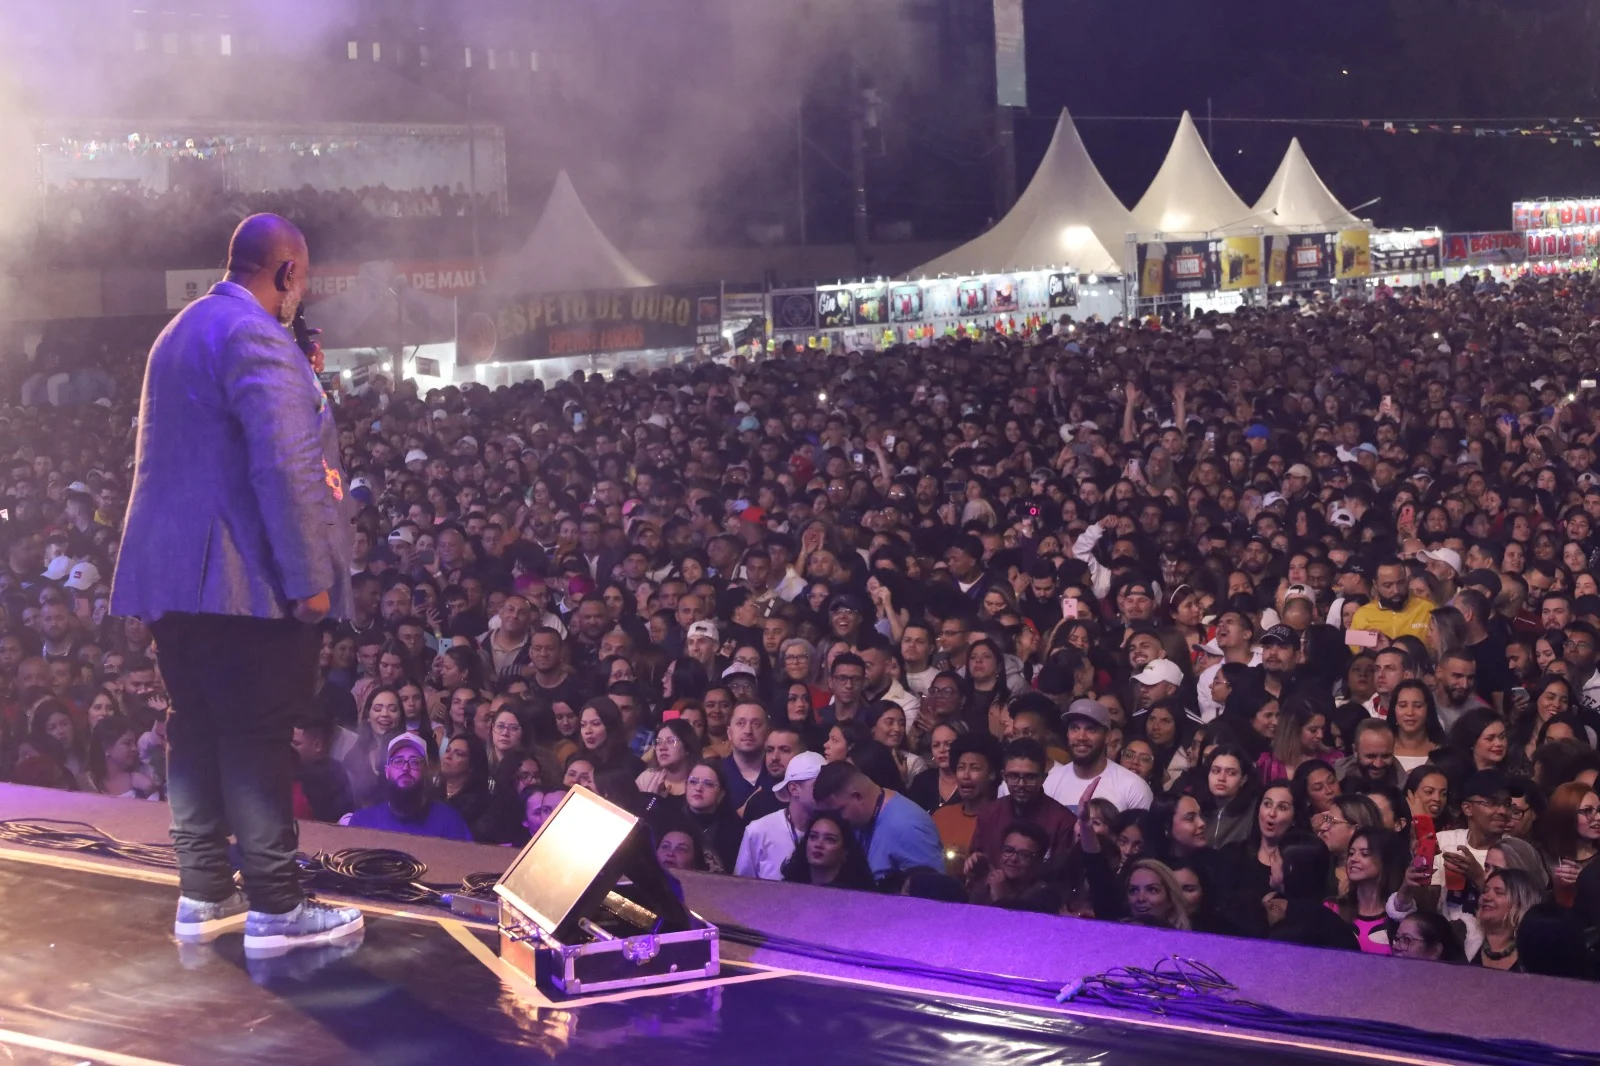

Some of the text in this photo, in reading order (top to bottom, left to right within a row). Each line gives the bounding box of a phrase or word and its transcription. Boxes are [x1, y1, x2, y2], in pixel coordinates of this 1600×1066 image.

[412, 272, 435, 290] DE
[497, 290, 690, 339] ESPETO DE OURO
[819, 292, 836, 315] Gin
